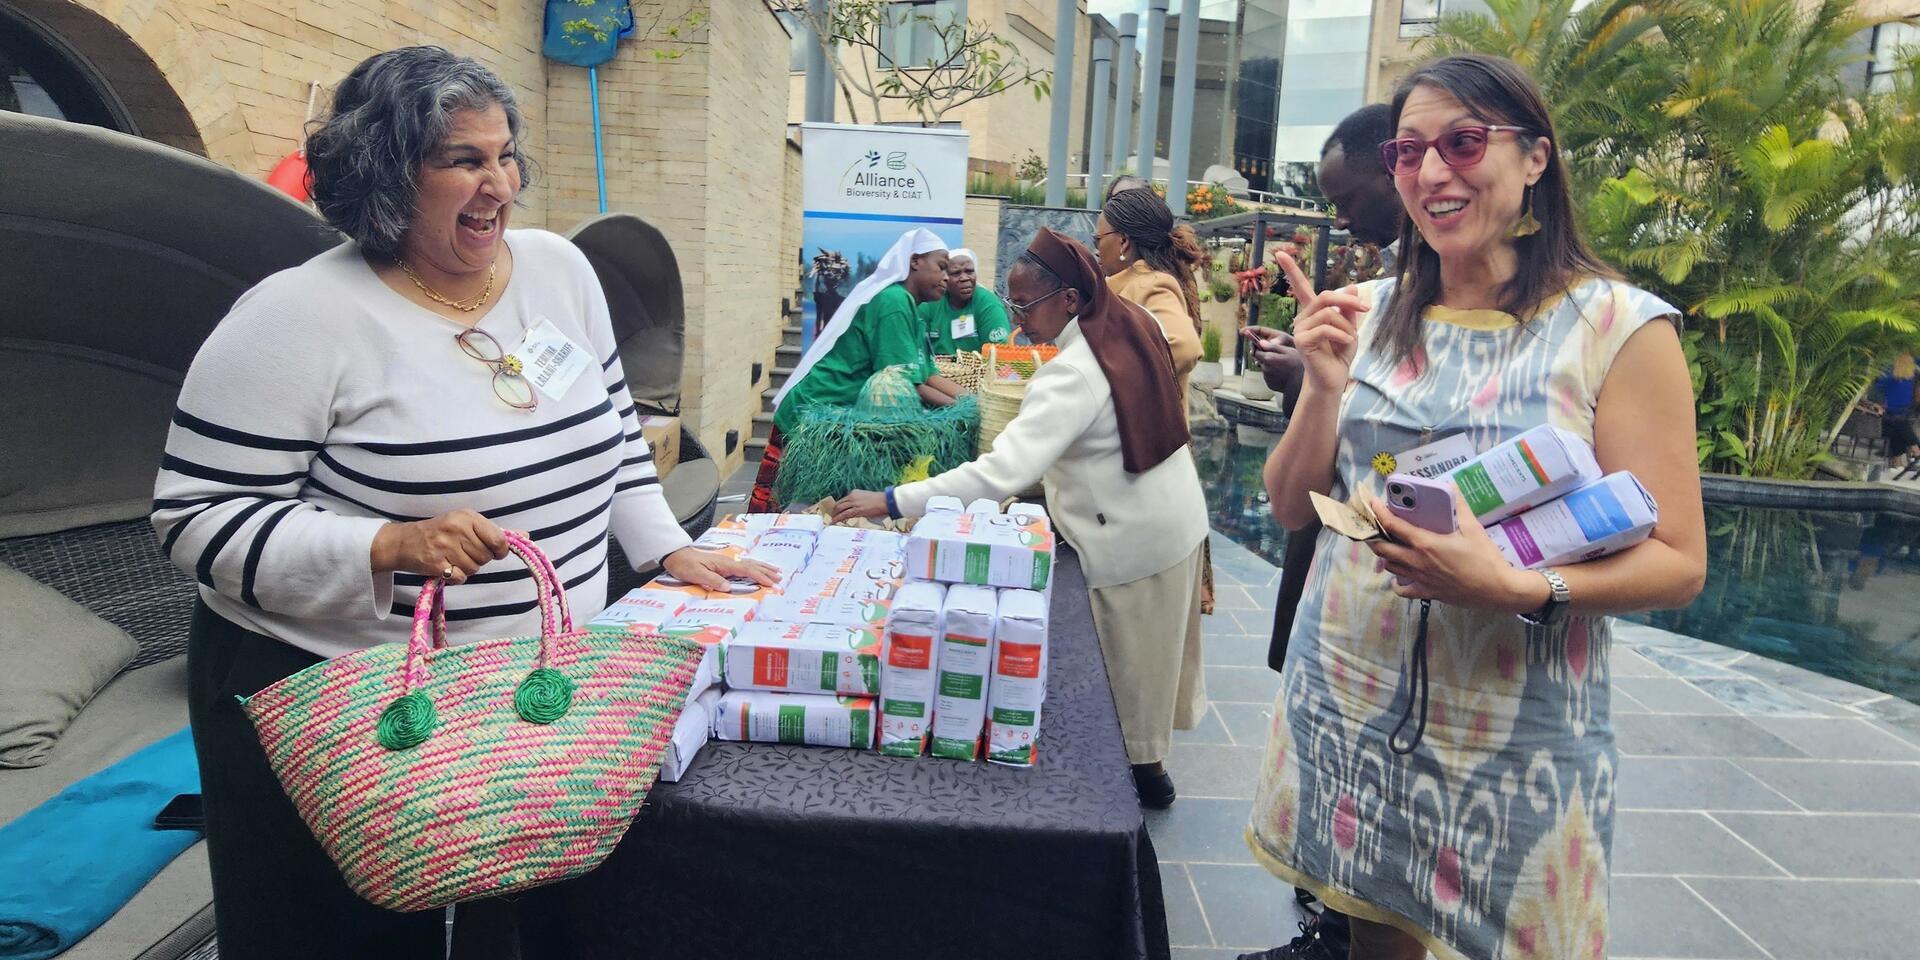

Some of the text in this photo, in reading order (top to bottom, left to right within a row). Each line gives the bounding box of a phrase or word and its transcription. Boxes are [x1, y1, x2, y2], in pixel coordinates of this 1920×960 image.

[854, 172, 915, 188] Alliance
[846, 188, 923, 200] Bioversity & CIAT
